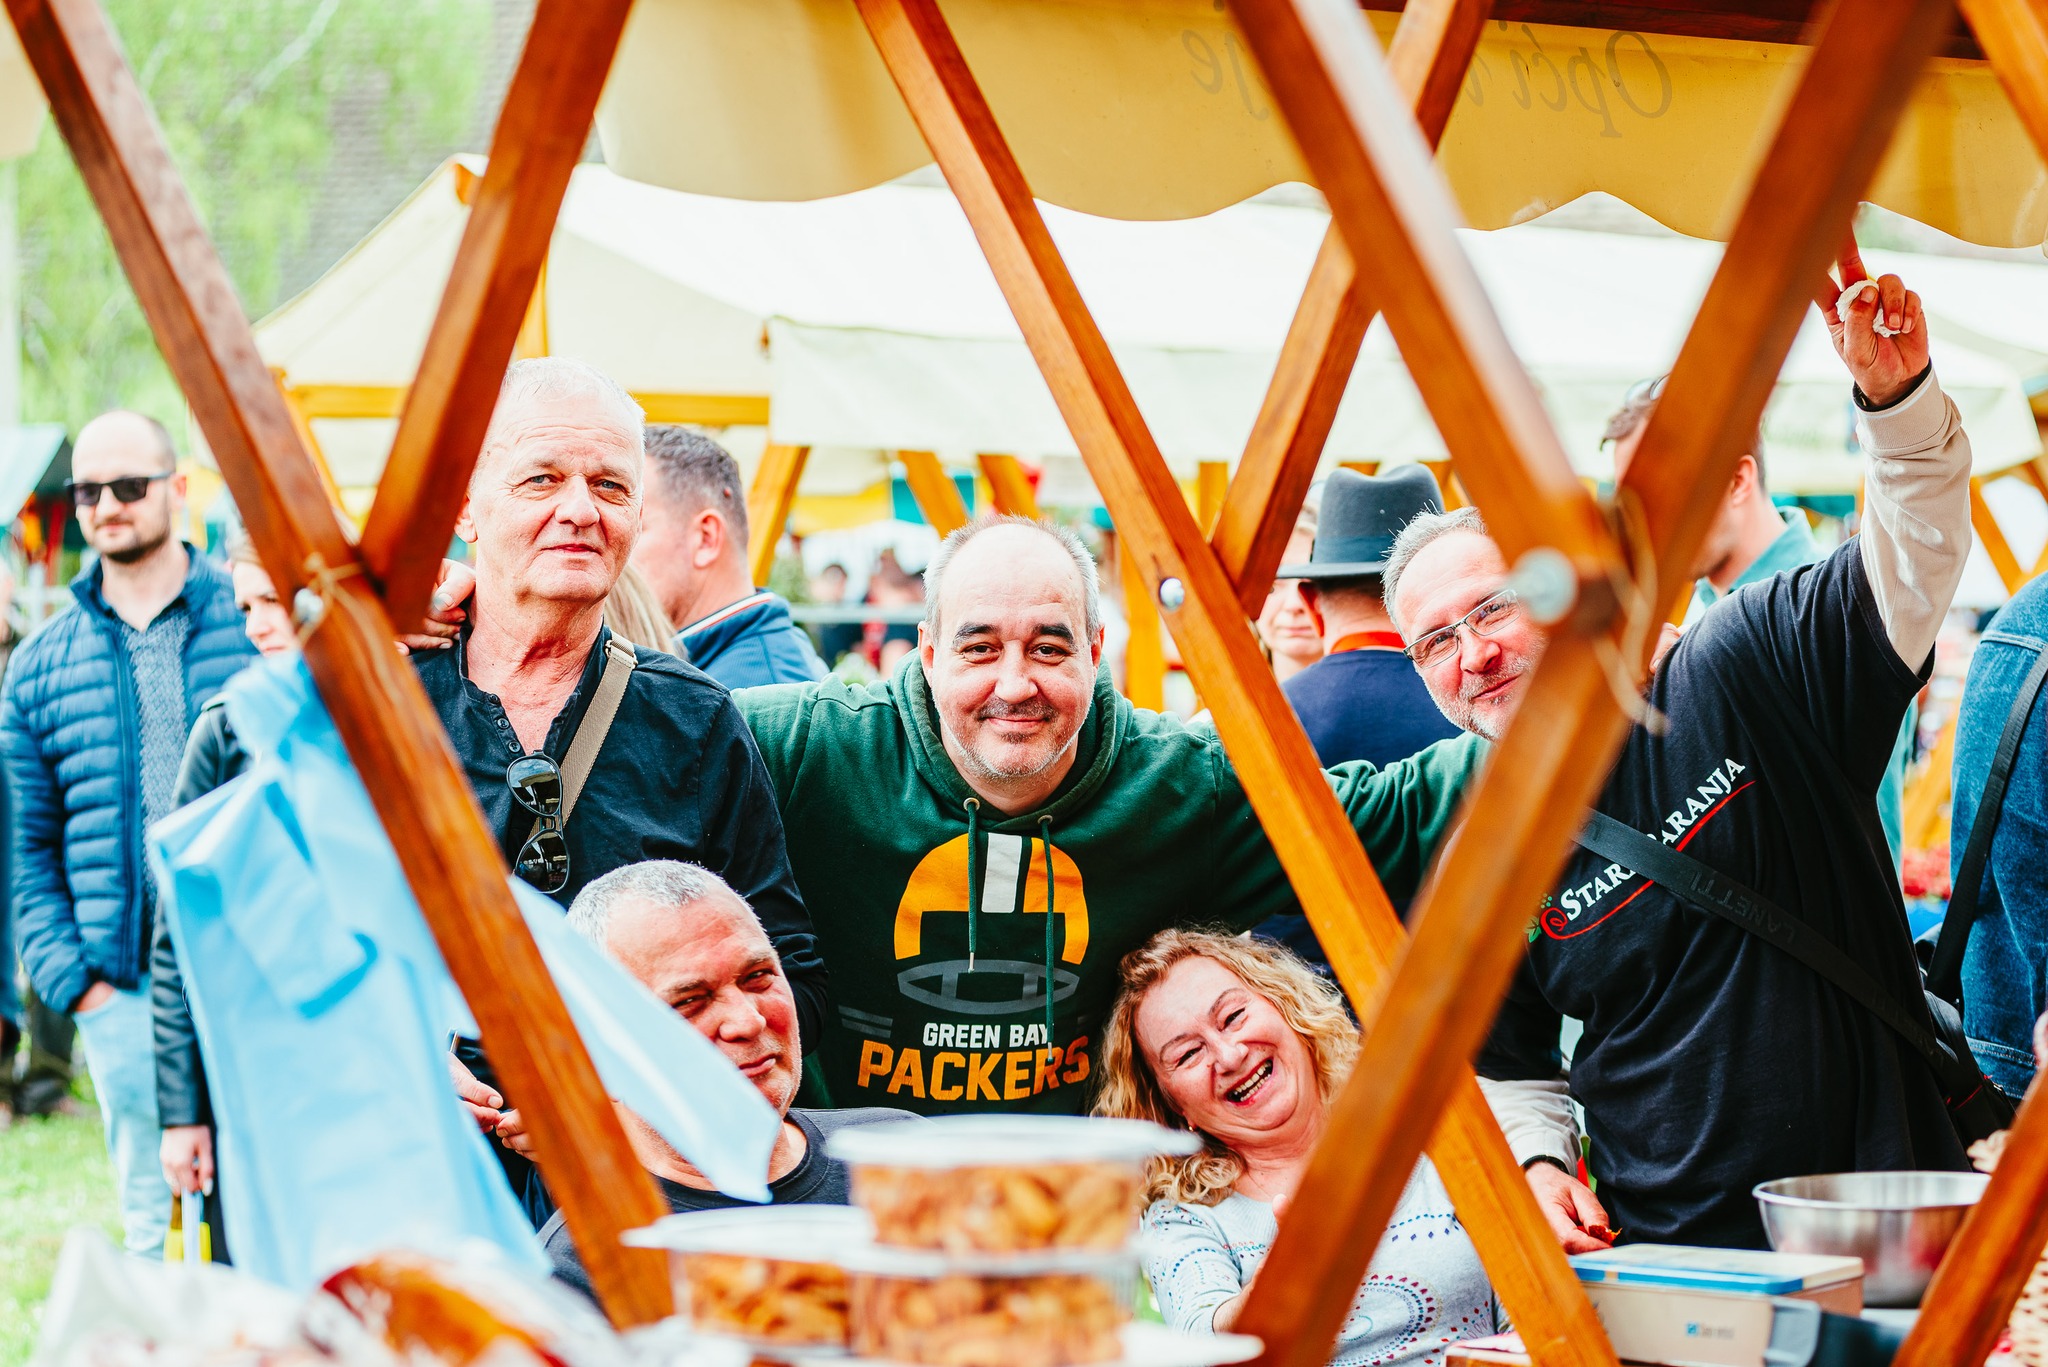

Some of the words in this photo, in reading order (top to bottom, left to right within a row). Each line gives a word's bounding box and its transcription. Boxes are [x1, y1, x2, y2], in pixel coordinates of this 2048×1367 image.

[922, 1021, 1001, 1049] GREEN
[1008, 1022, 1049, 1049] BAY
[857, 1034, 1091, 1102] PACKERS
